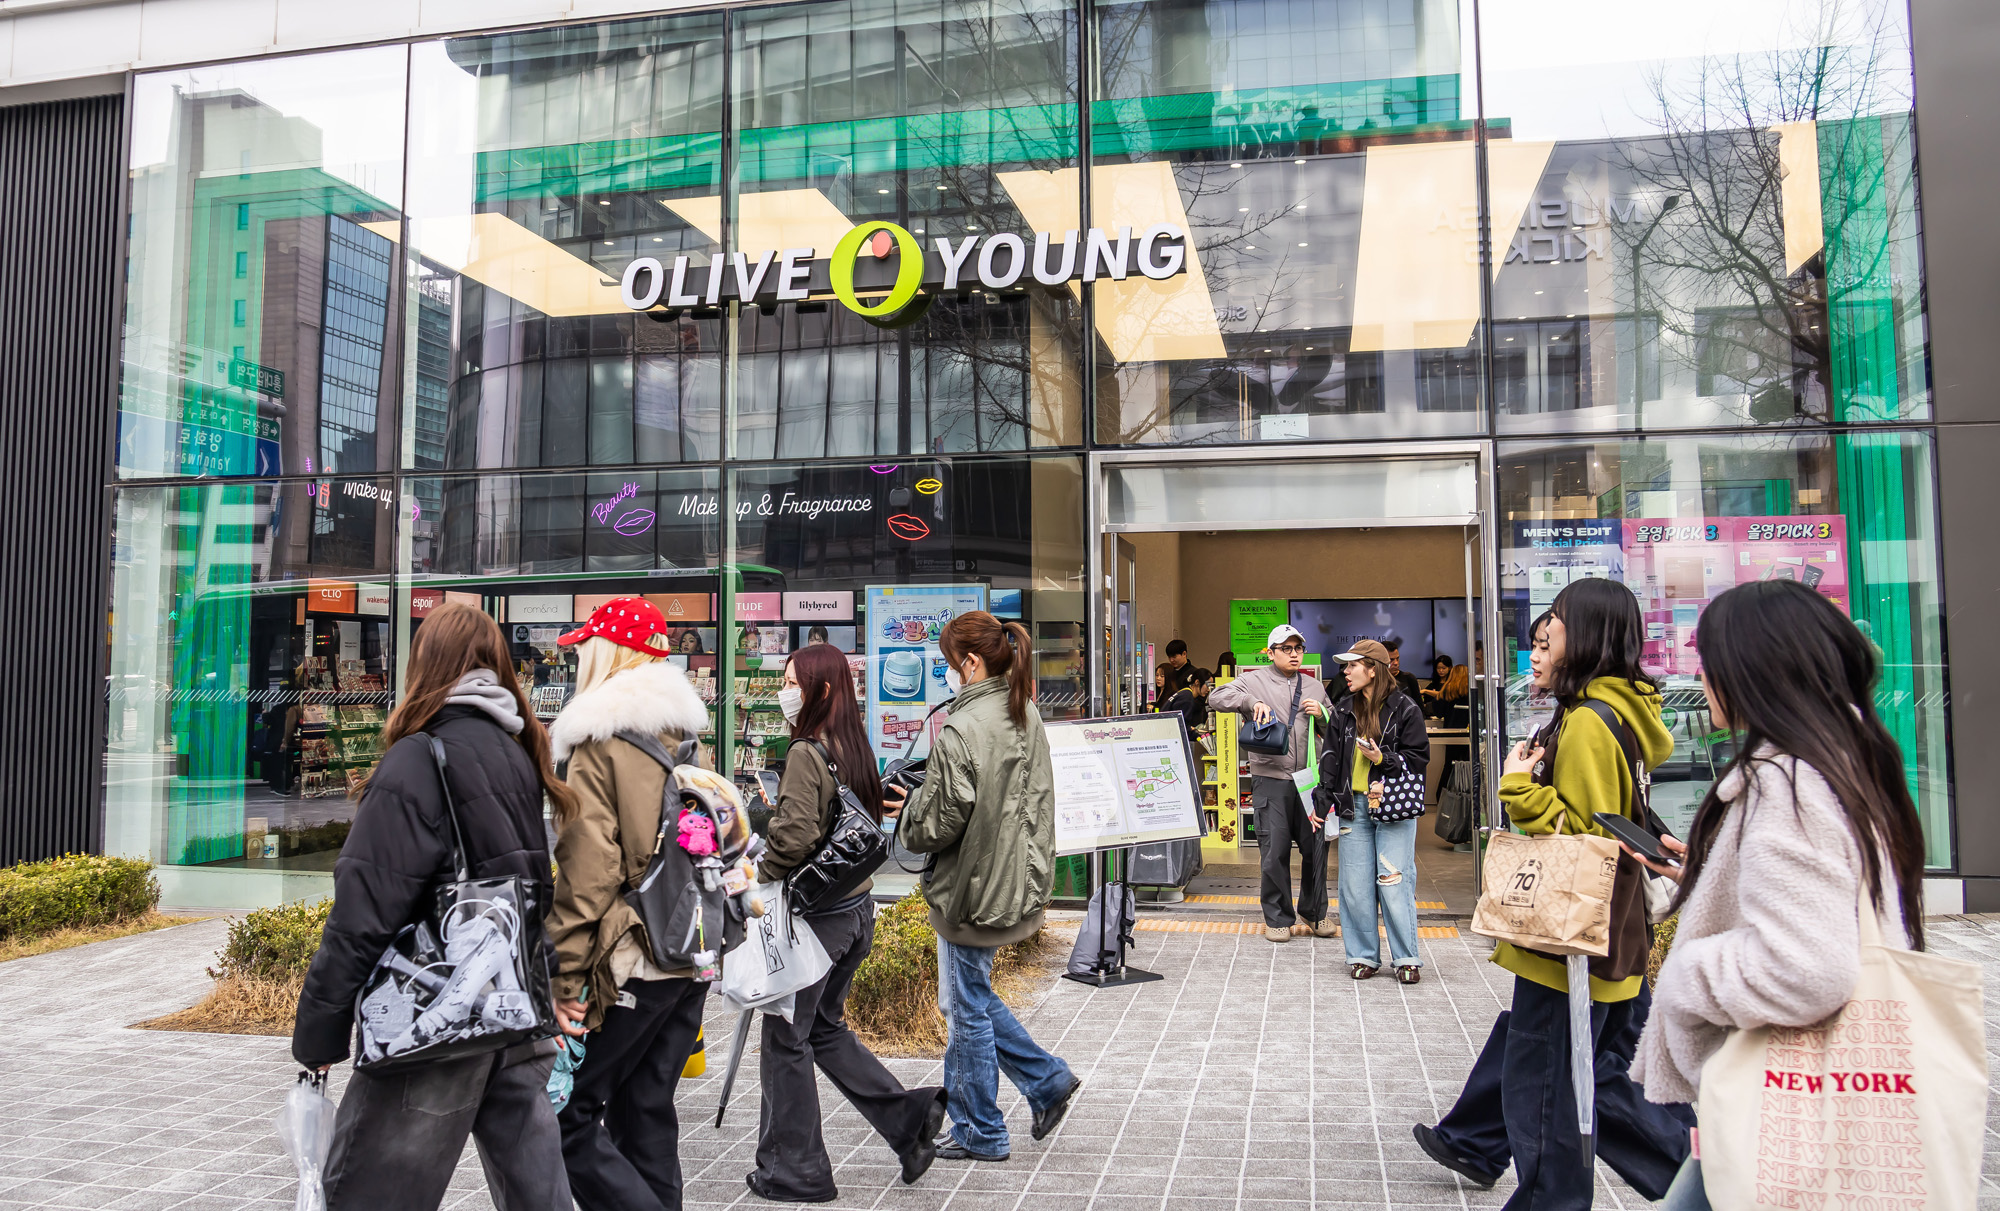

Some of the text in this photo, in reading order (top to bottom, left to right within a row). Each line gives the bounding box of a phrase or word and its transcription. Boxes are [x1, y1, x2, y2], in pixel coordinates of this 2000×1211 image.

[620, 247, 815, 310] OLIVE
[935, 223, 1186, 290] YOUNG
[343, 481, 392, 510] Make up
[591, 481, 640, 525] Beauty
[678, 495, 718, 518] Mak
[756, 493, 774, 516] &
[779, 493, 873, 520] Fragrance
[1522, 526, 1613, 538] MEN'S EDIT
[1532, 537, 1604, 551] Special Price
[321, 588, 342, 598] CLIO
[413, 597, 433, 611] espoir
[736, 602, 762, 611] TUDE
[799, 601, 837, 611] lilybyred
[1514, 873, 1536, 891] 70
[1832, 1023, 1913, 1046] YORK
[1765, 1047, 1915, 1070] NEW YORK
[1764, 1070, 1916, 1094] NEW YORK
[1761, 1091, 1919, 1120] NEW YORK
[1760, 1113, 1922, 1145] NEW YORK
[1758, 1135, 1925, 1169] NEW YORK
[1757, 1158, 1927, 1195] NEW YORK
[1756, 1182, 1926, 1211] NEW YORK
